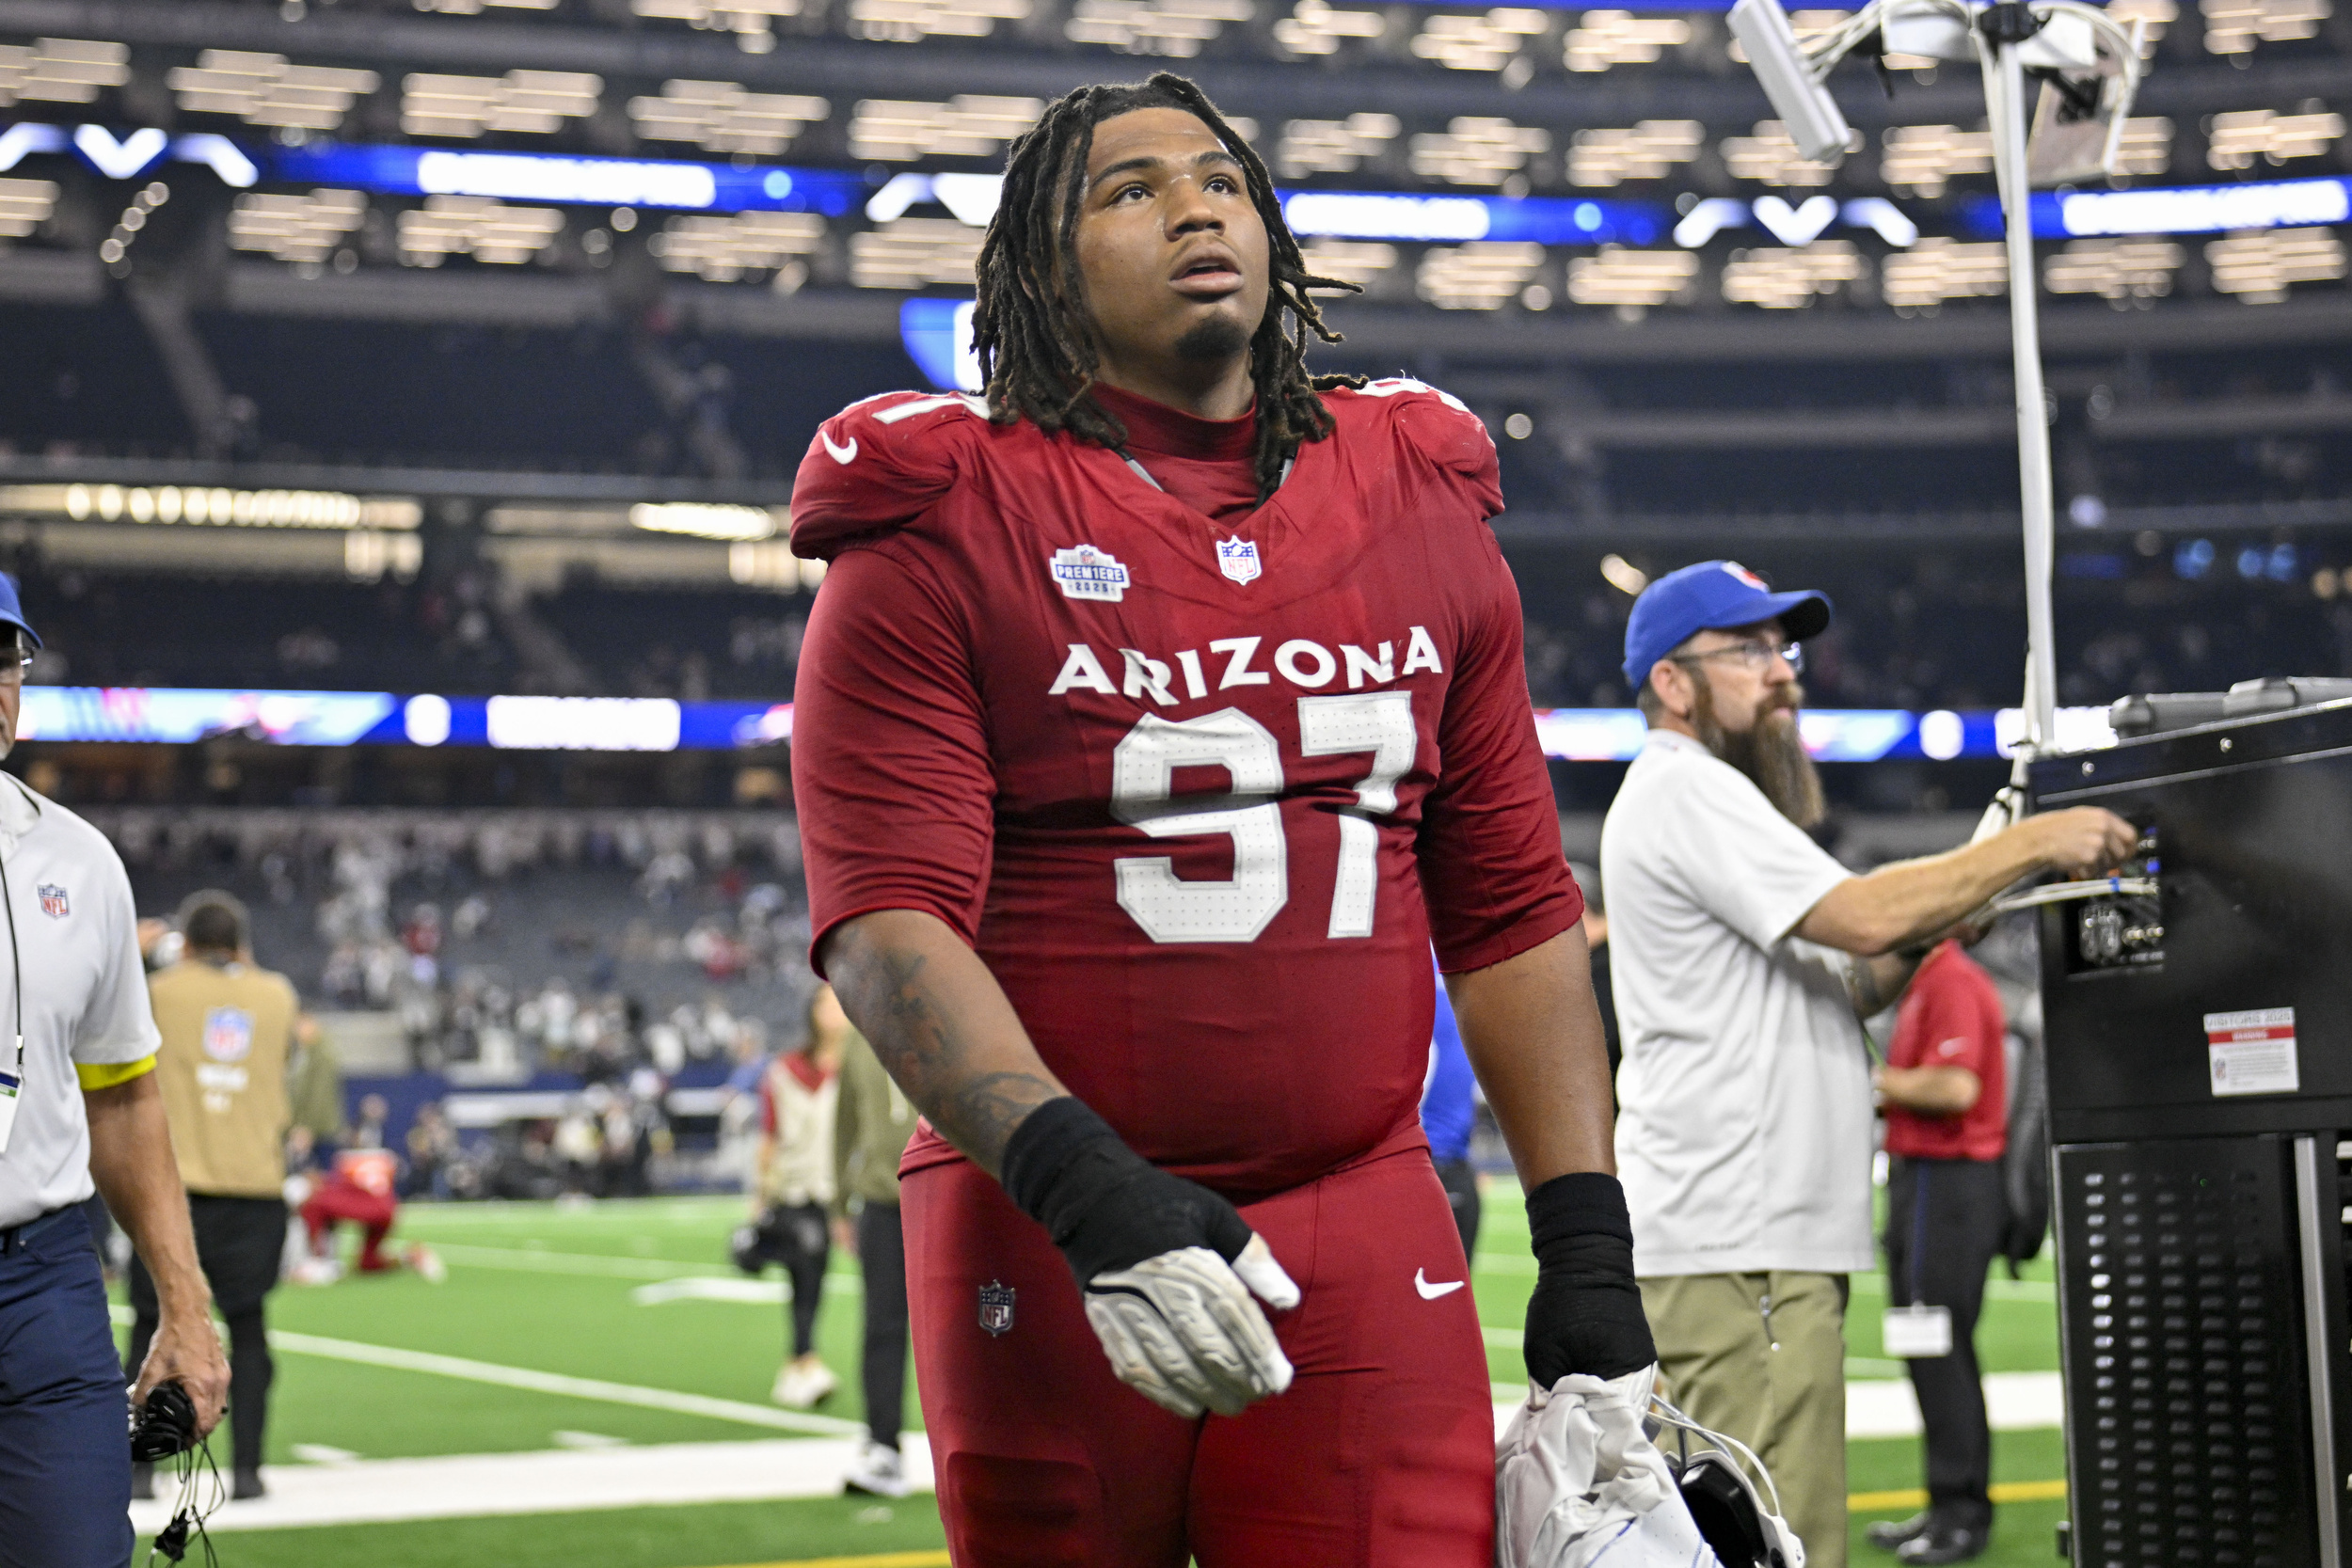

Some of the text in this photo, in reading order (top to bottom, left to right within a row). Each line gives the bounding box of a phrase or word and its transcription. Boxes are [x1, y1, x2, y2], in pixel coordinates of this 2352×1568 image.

[1226, 558, 1254, 575] NFL
[1075, 581, 1108, 593] 2025
[1048, 626, 1443, 705] ARIZONA
[1109, 690, 1418, 943] 97
[42, 897, 67, 914] NFL
[983, 1305, 1009, 1326] NFL
